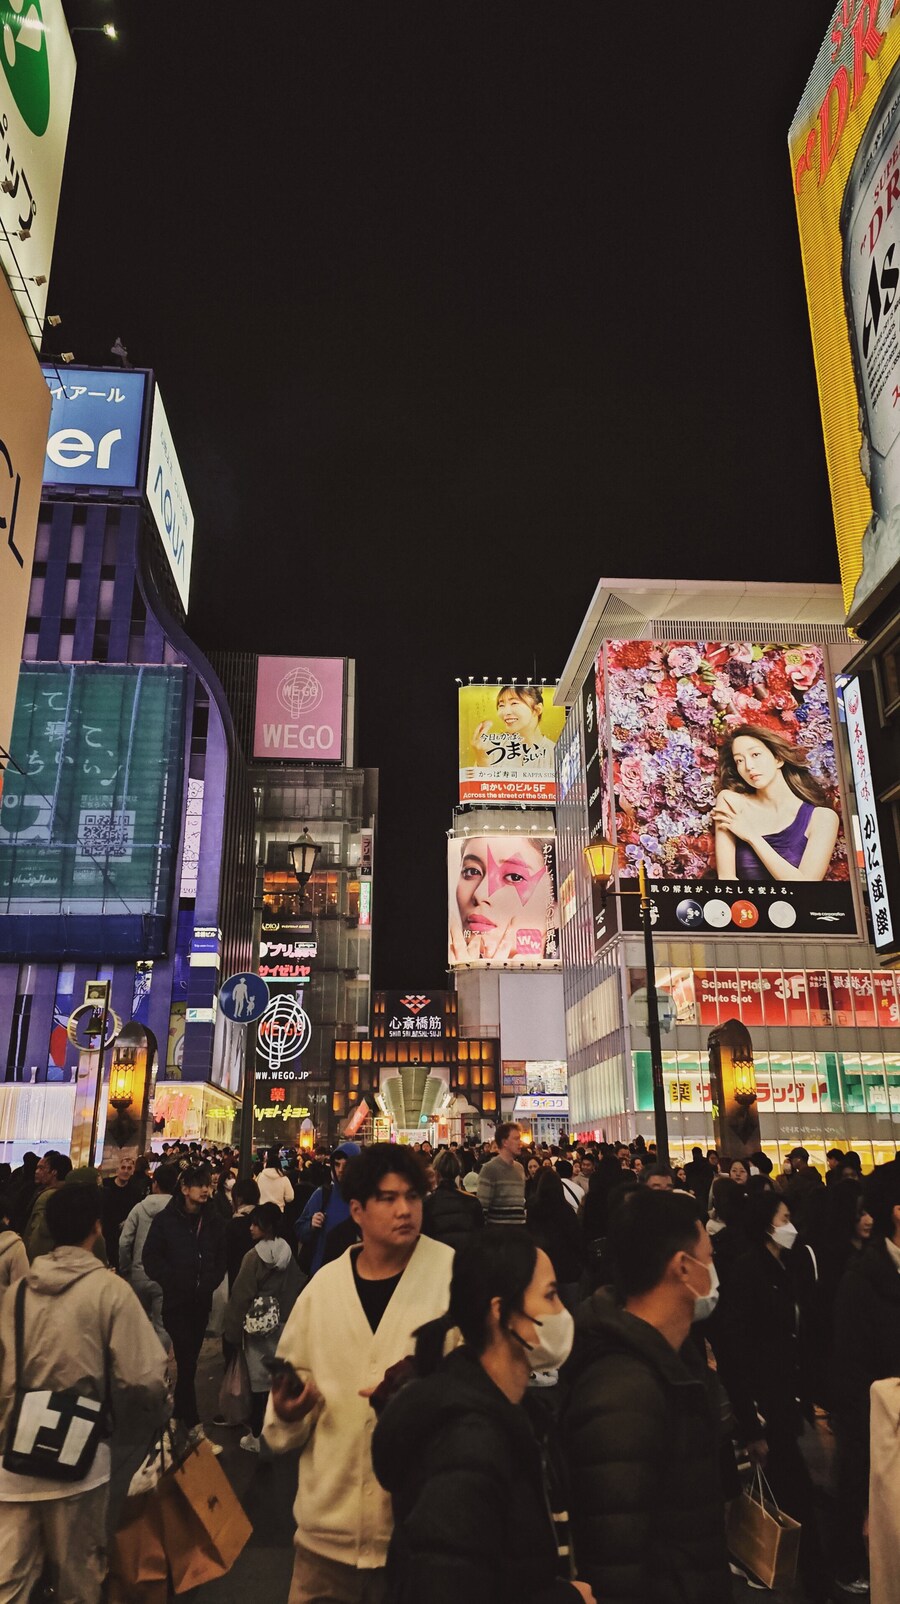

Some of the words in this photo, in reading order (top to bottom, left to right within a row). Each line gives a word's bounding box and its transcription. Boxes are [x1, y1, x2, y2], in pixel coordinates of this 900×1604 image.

[263, 724, 334, 749] WEGO
[486, 741, 540, 765] うまい
[258, 965, 311, 976] サイゼリヤ
[701, 979, 738, 988] Scenic
[740, 979, 770, 989] Place
[774, 977, 804, 998] 3F
[702, 994, 728, 1002] Photo
[730, 994, 751, 1003] Spot
[389, 1016, 441, 1029] 心斎橋筋
[672, 1082, 690, 1102] 薬
[253, 1104, 310, 1121] ツモトキヨシ
